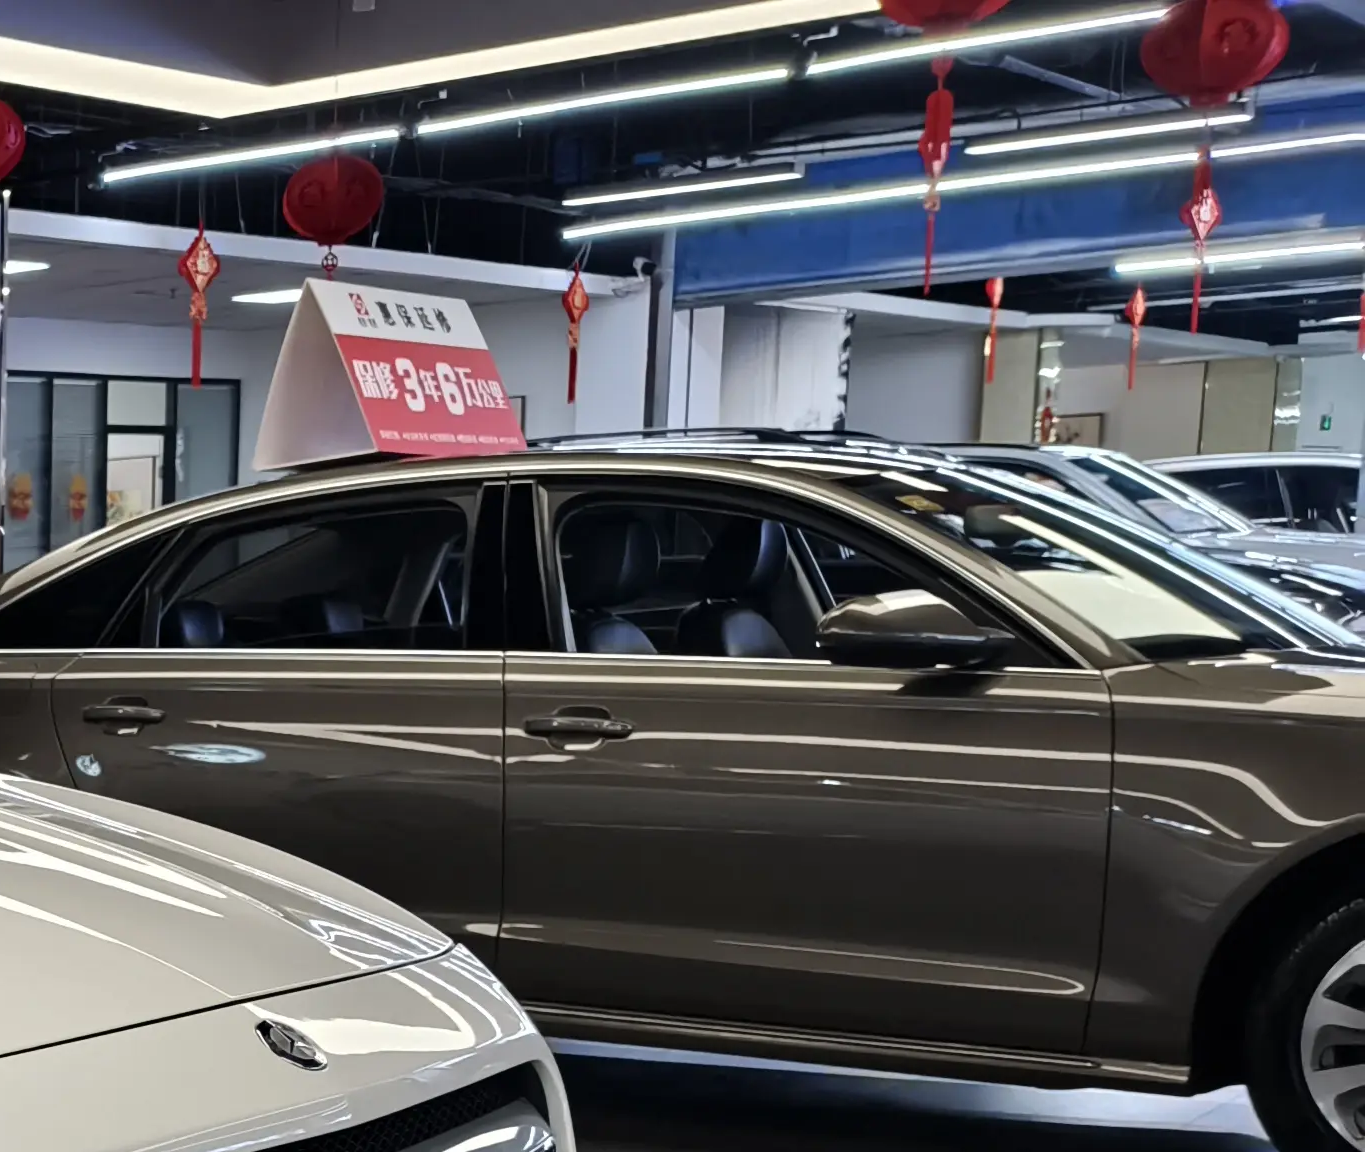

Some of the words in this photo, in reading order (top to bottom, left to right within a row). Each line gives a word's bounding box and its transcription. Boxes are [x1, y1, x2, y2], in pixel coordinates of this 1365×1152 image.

[352, 358, 509, 416] 保修3年6万公里
